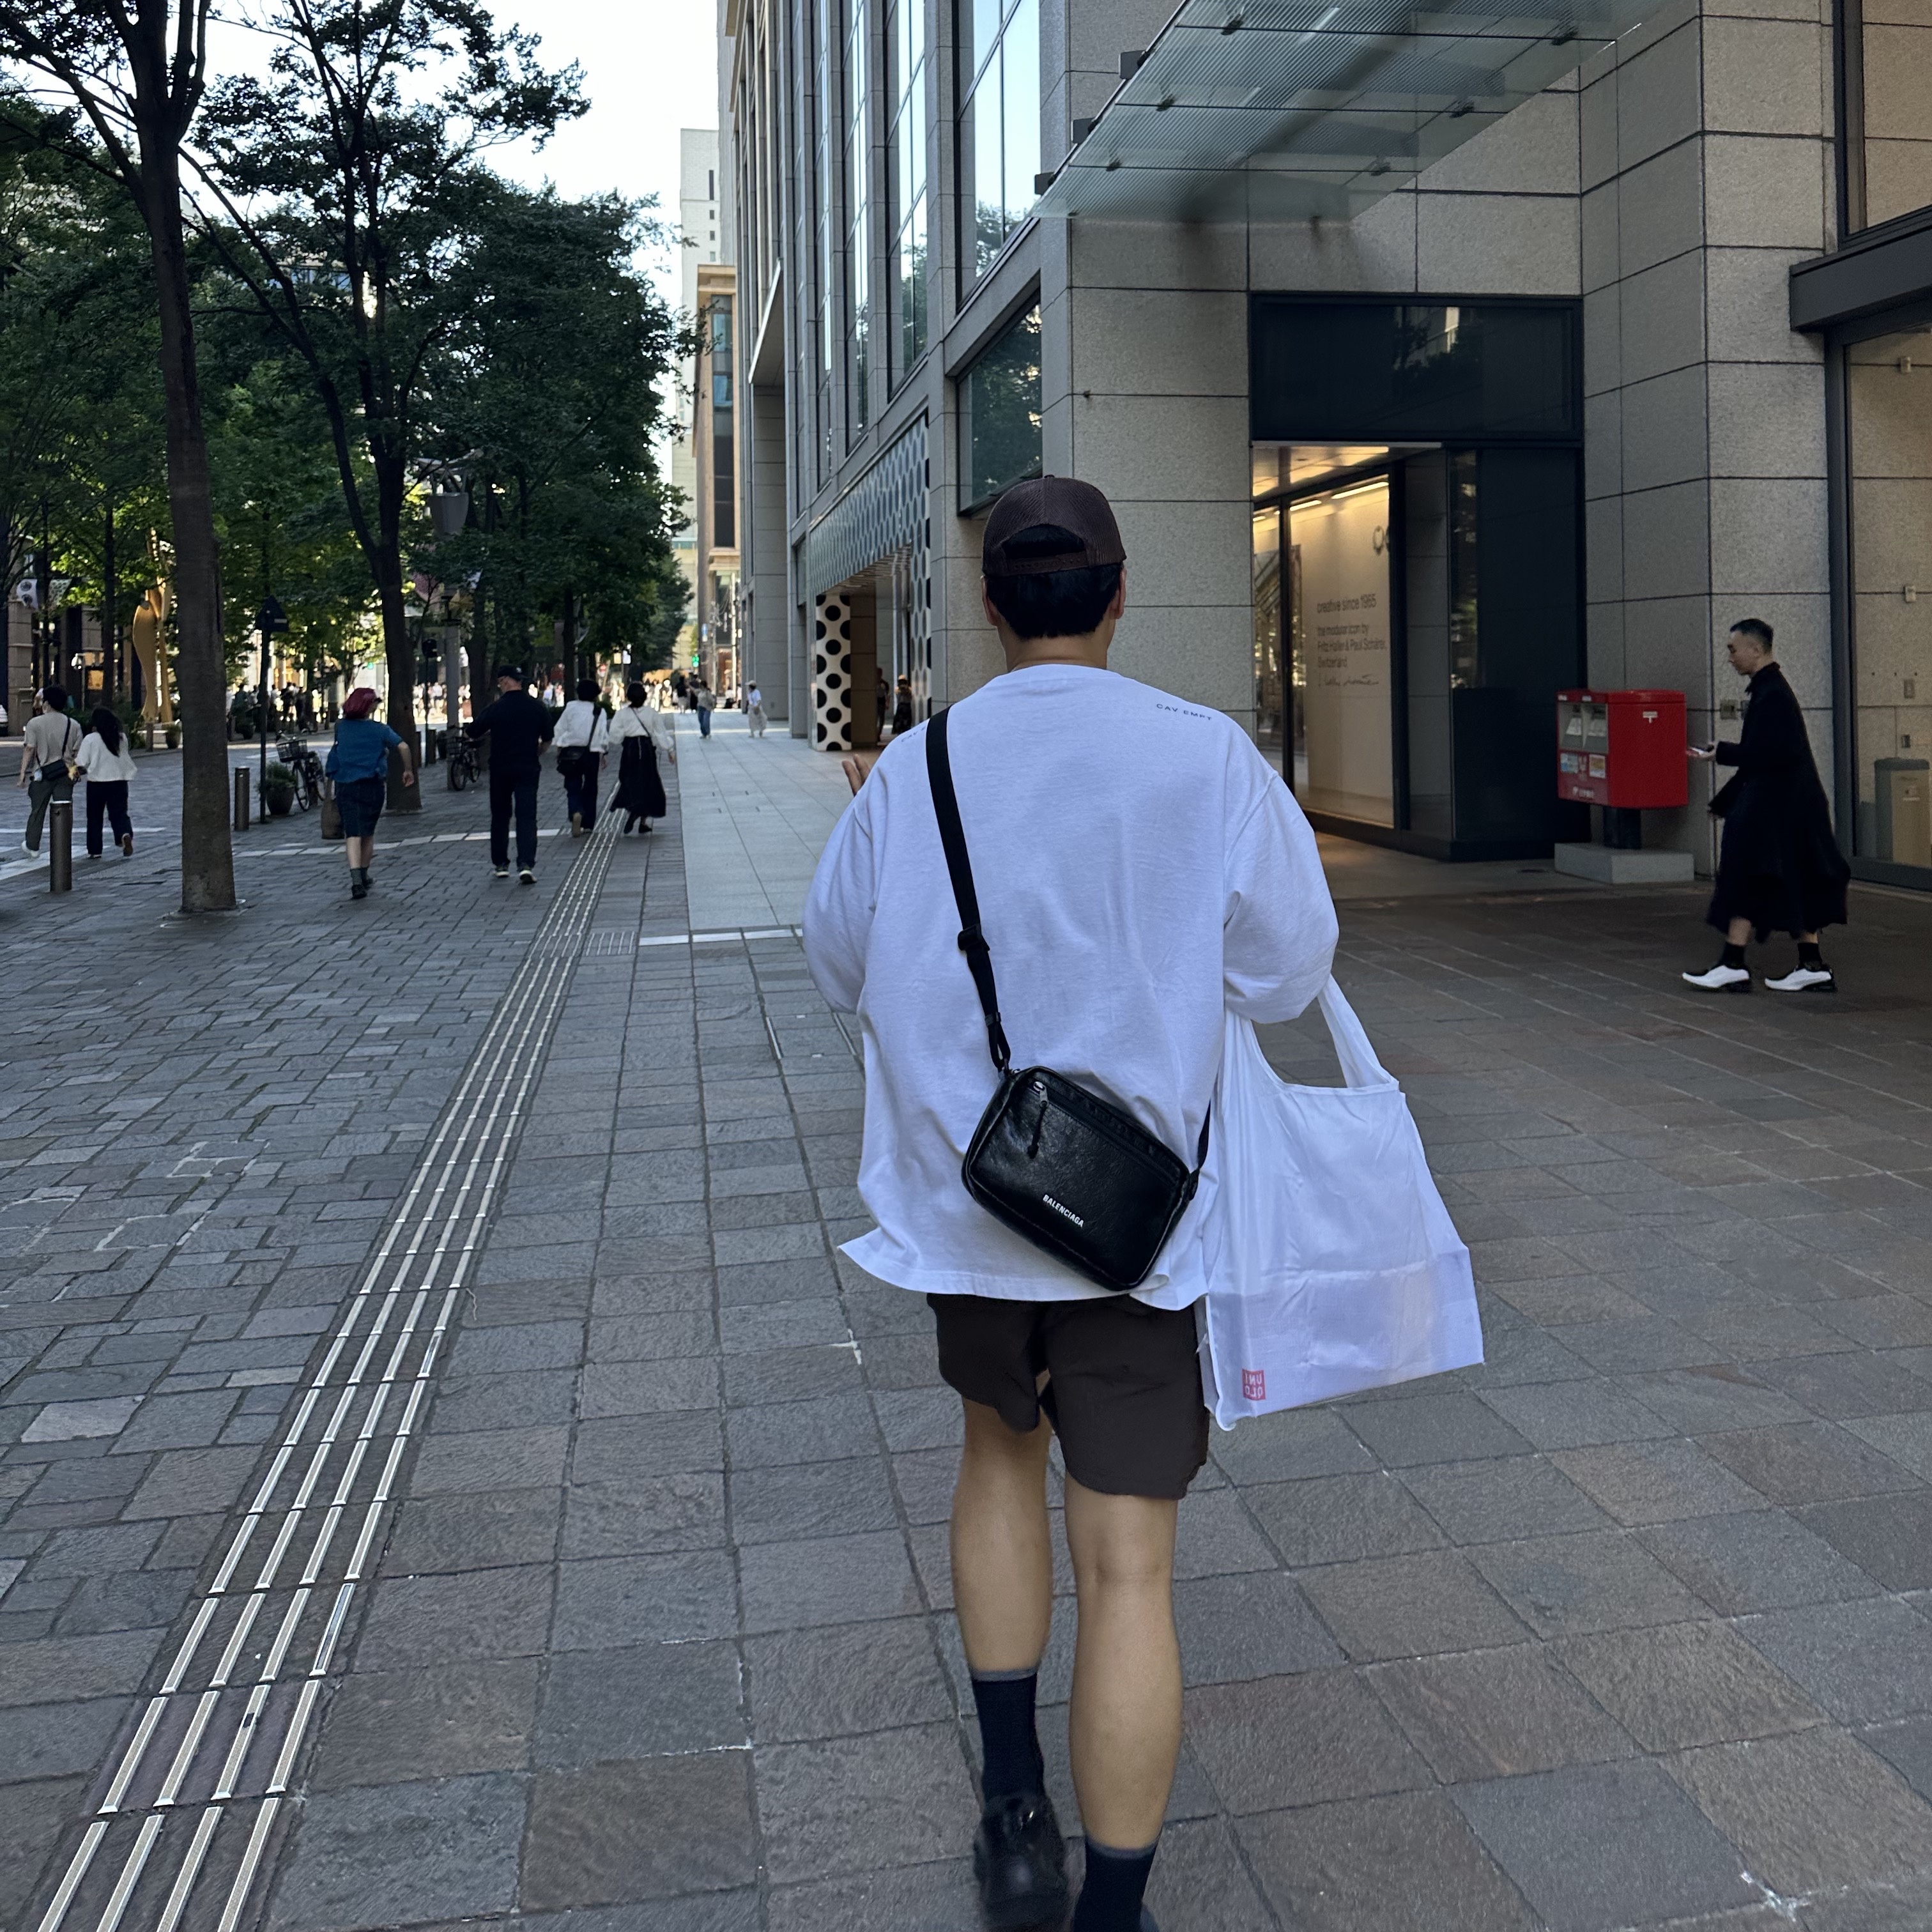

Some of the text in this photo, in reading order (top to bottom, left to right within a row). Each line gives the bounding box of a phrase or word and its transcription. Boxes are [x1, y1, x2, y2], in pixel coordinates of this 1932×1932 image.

[1317, 599, 1340, 613] creative
[1342, 597, 1359, 611] since
[1361, 623, 1369, 635] by
[1156, 703, 1178, 712] CAV
[1043, 1194, 1084, 1228] BALENCIAGA
